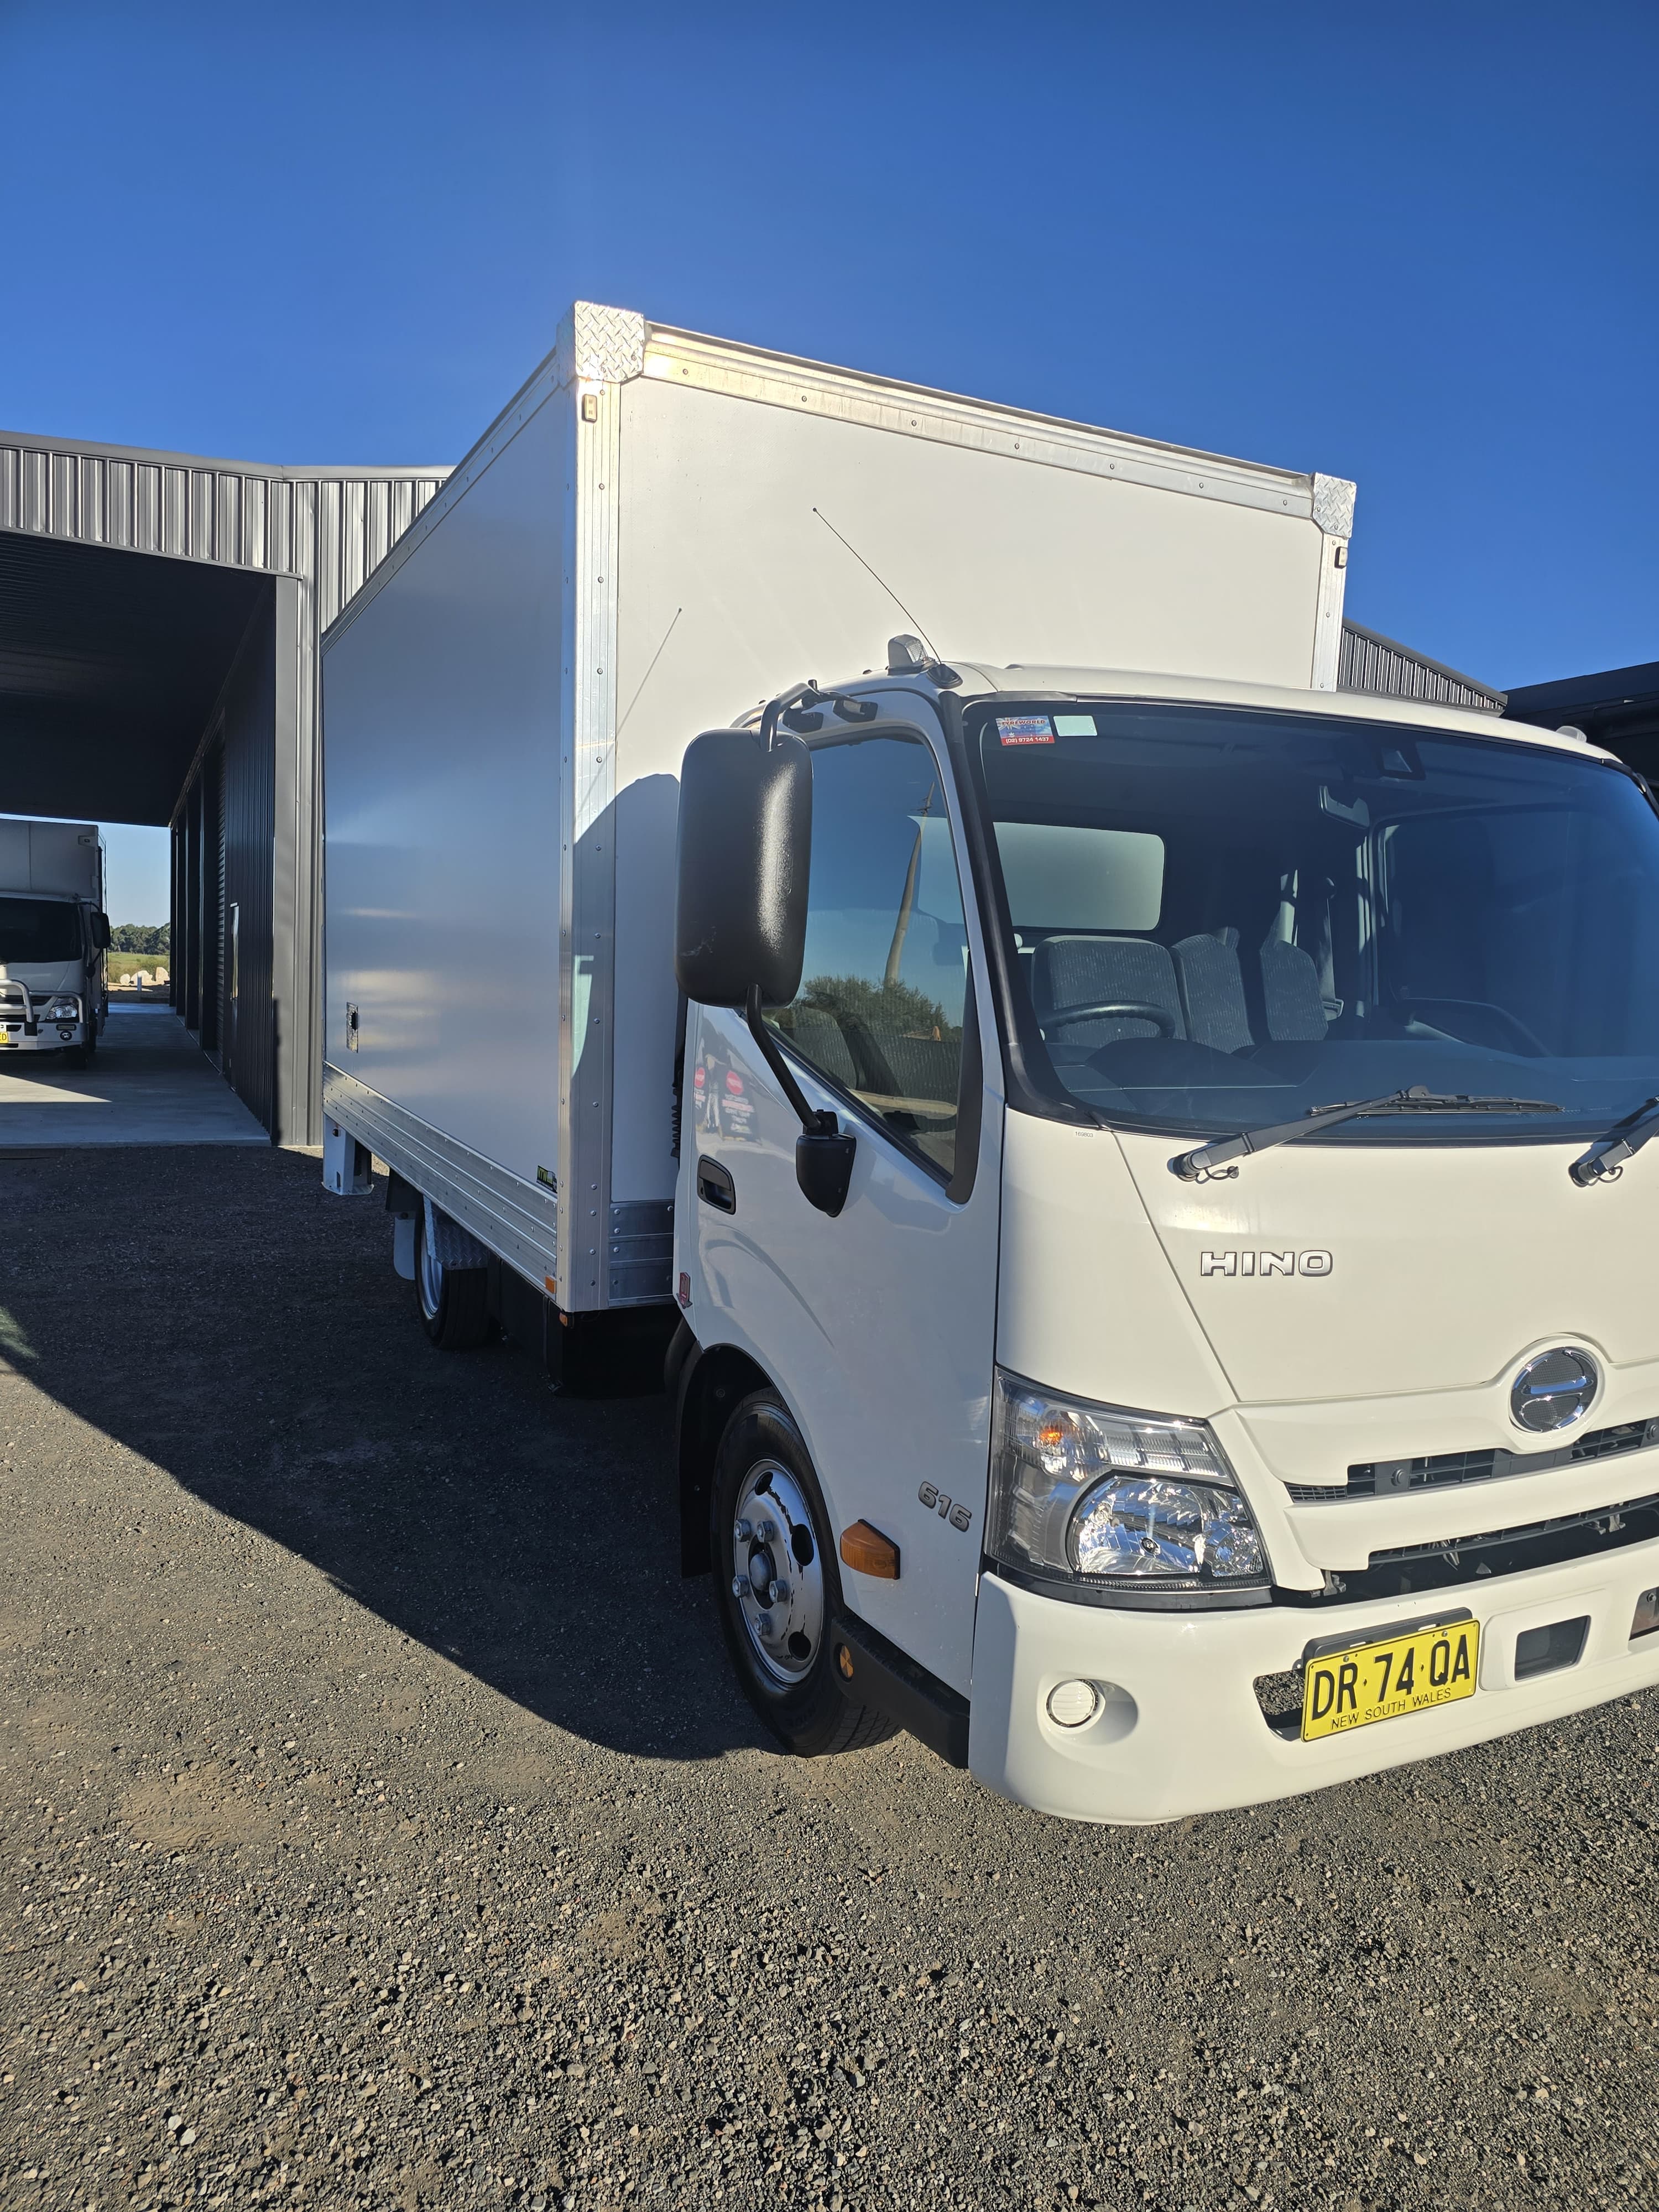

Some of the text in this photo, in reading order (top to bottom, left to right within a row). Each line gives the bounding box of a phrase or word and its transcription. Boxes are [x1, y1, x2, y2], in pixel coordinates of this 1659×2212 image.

[1201, 1250, 1333, 1277] HINO
[918, 1481, 972, 1532] 616
[1331, 1687, 1451, 1730] NEW SOUTH WALES
